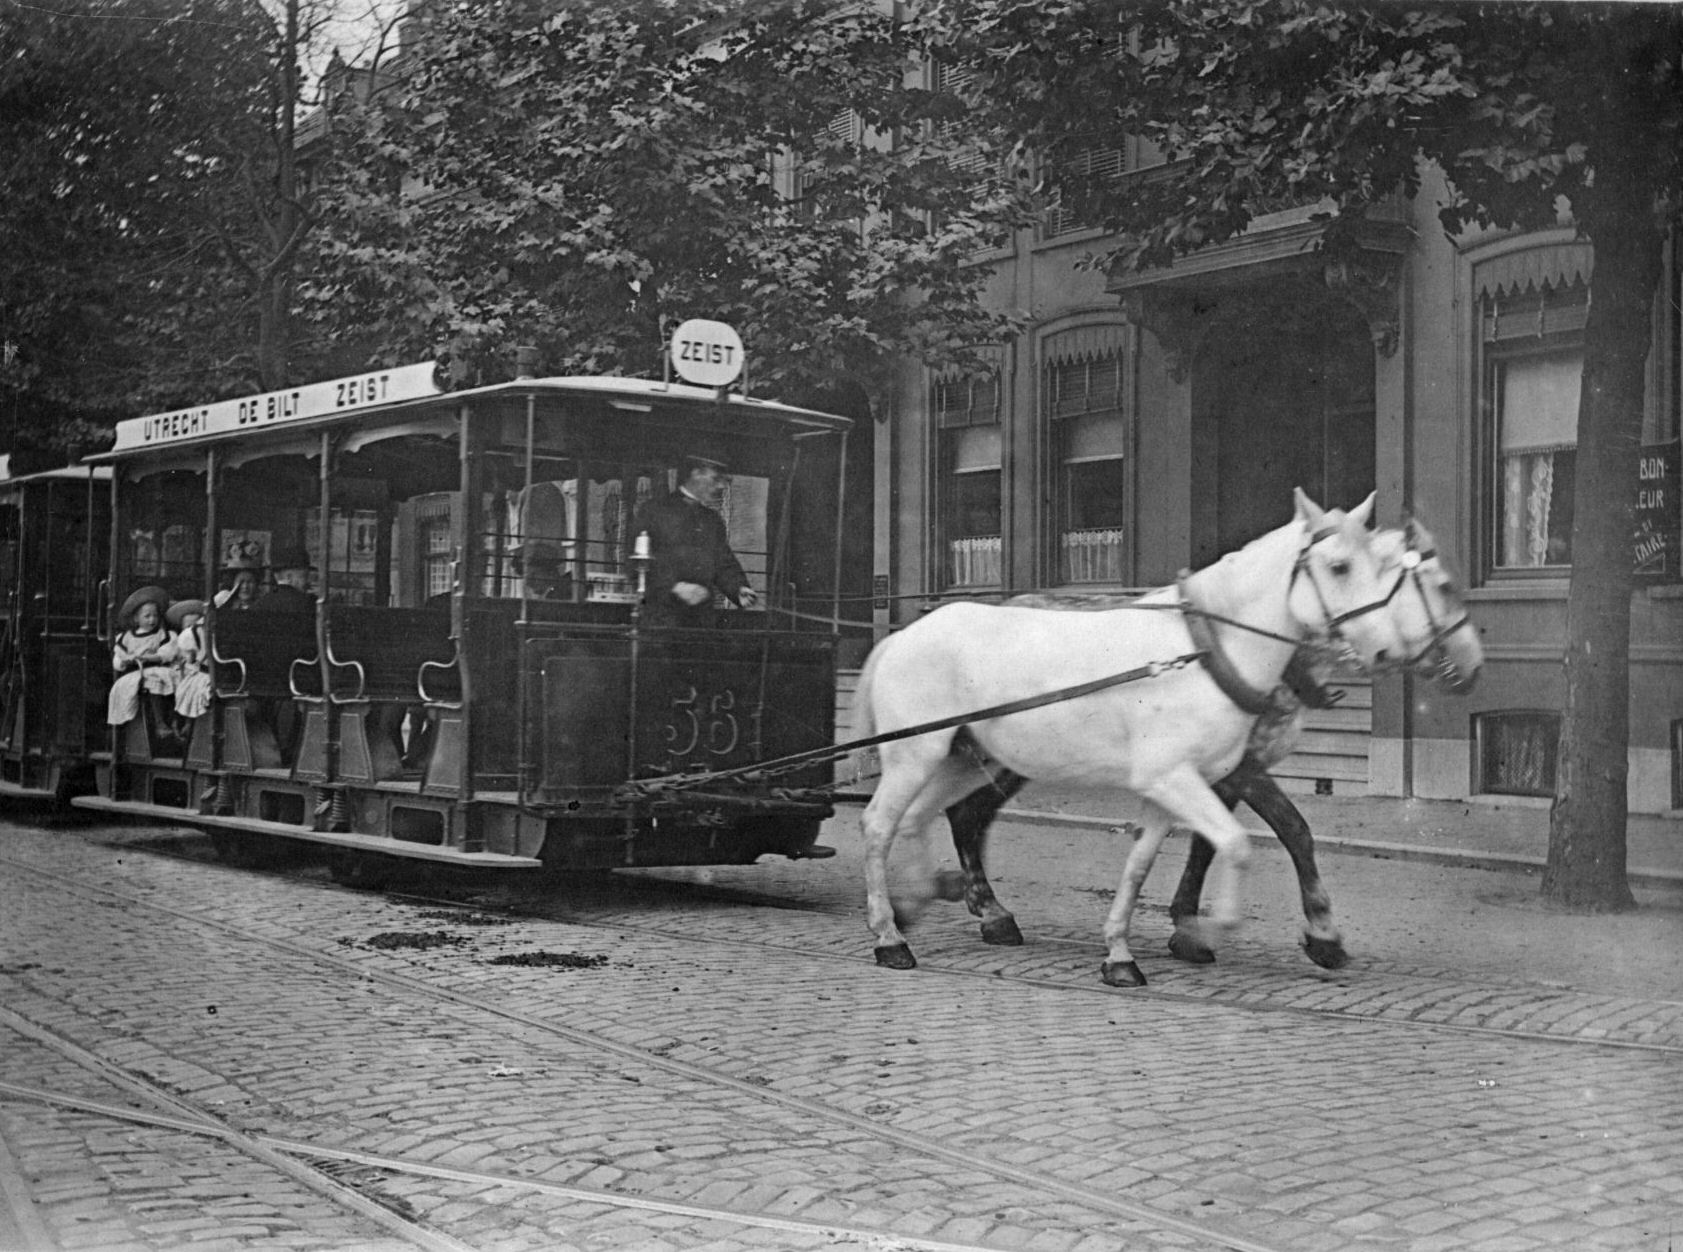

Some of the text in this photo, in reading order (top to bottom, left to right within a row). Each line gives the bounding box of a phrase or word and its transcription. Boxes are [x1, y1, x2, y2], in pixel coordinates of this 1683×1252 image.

[680, 340, 735, 366] ZEIST
[144, 375, 390, 441] UTRECHT DE BILT ZEIST
[1635, 489, 1664, 509] EUR
[663, 686, 738, 756] 56
